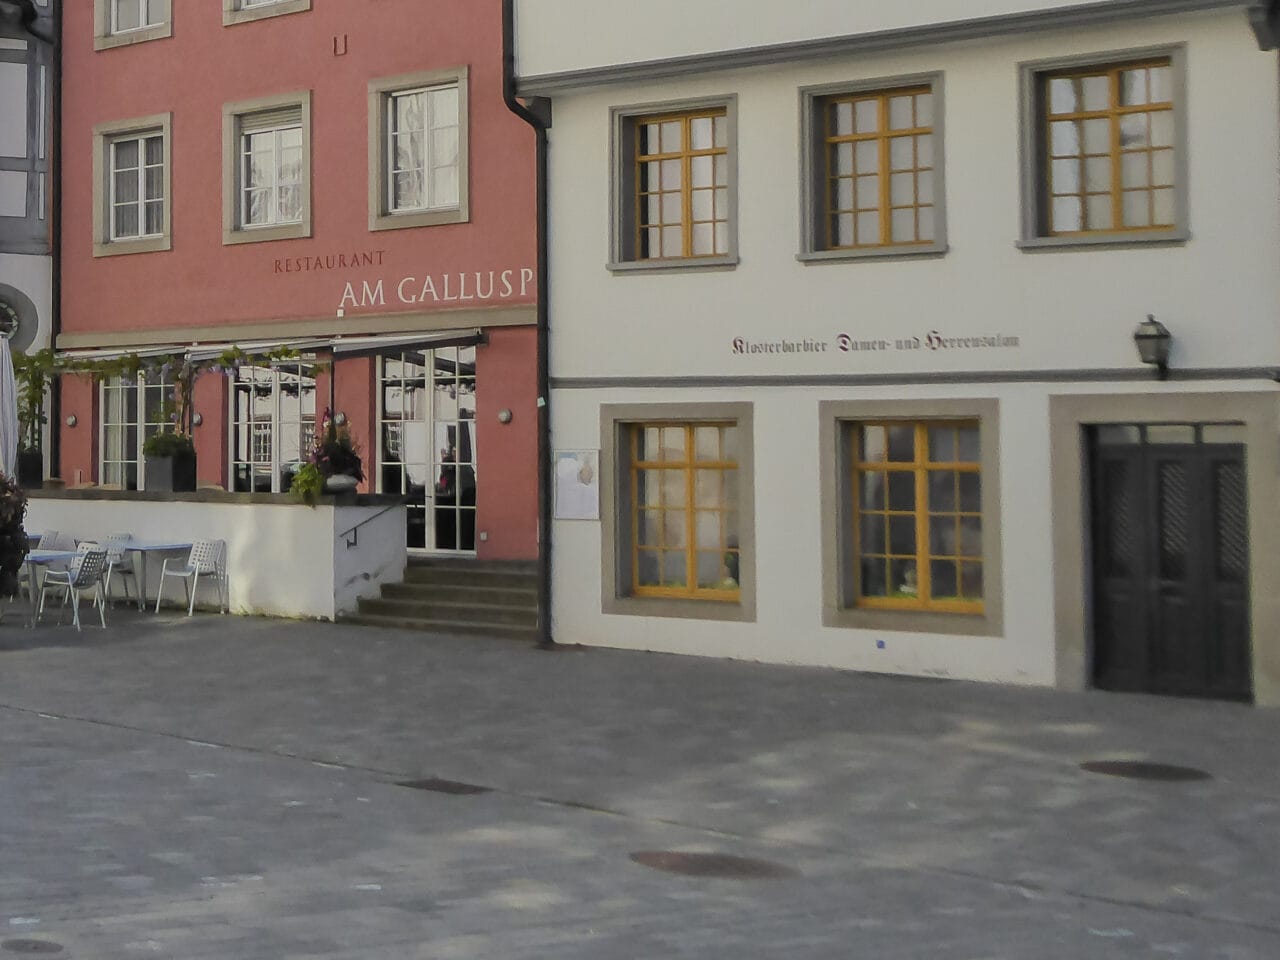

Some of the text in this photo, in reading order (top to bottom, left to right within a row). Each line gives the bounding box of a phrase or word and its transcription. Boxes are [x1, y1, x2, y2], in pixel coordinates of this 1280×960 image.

[274, 250, 386, 274] RESTAURANT
[339, 279, 386, 308] AM
[732, 336, 828, 354] Klosterbarbier
[895, 336, 919, 350] und
